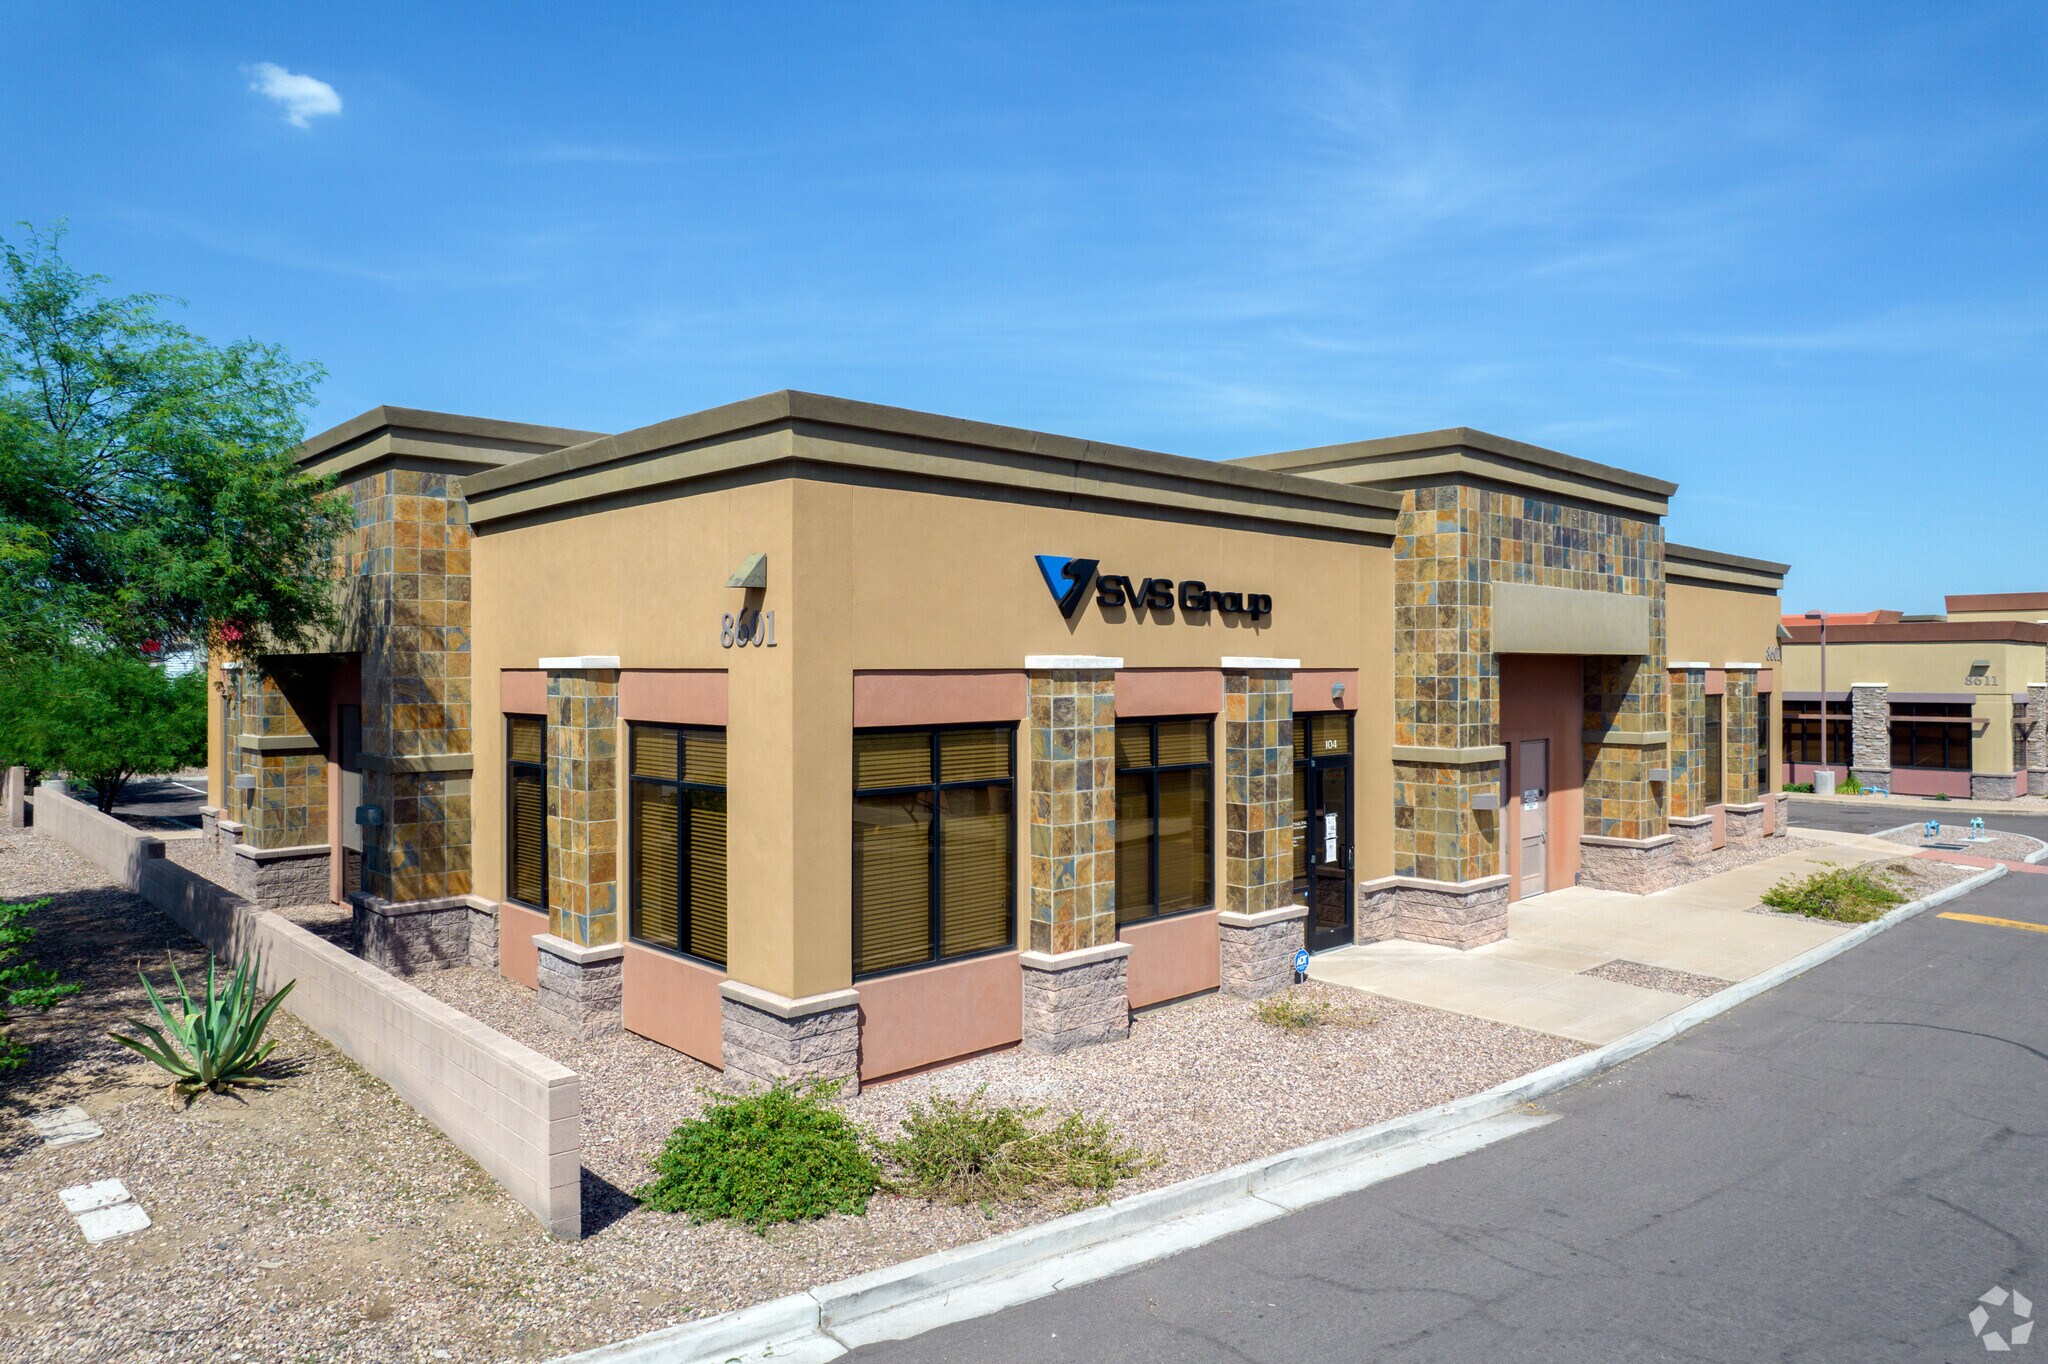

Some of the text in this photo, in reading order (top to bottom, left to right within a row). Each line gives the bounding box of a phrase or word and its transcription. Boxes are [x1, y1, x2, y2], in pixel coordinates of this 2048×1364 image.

[1096, 575, 1273, 621] SVS Group
[721, 607, 777, 648] 8601
[1964, 675, 1999, 687] 8611
[1325, 739, 1338, 749] 104
